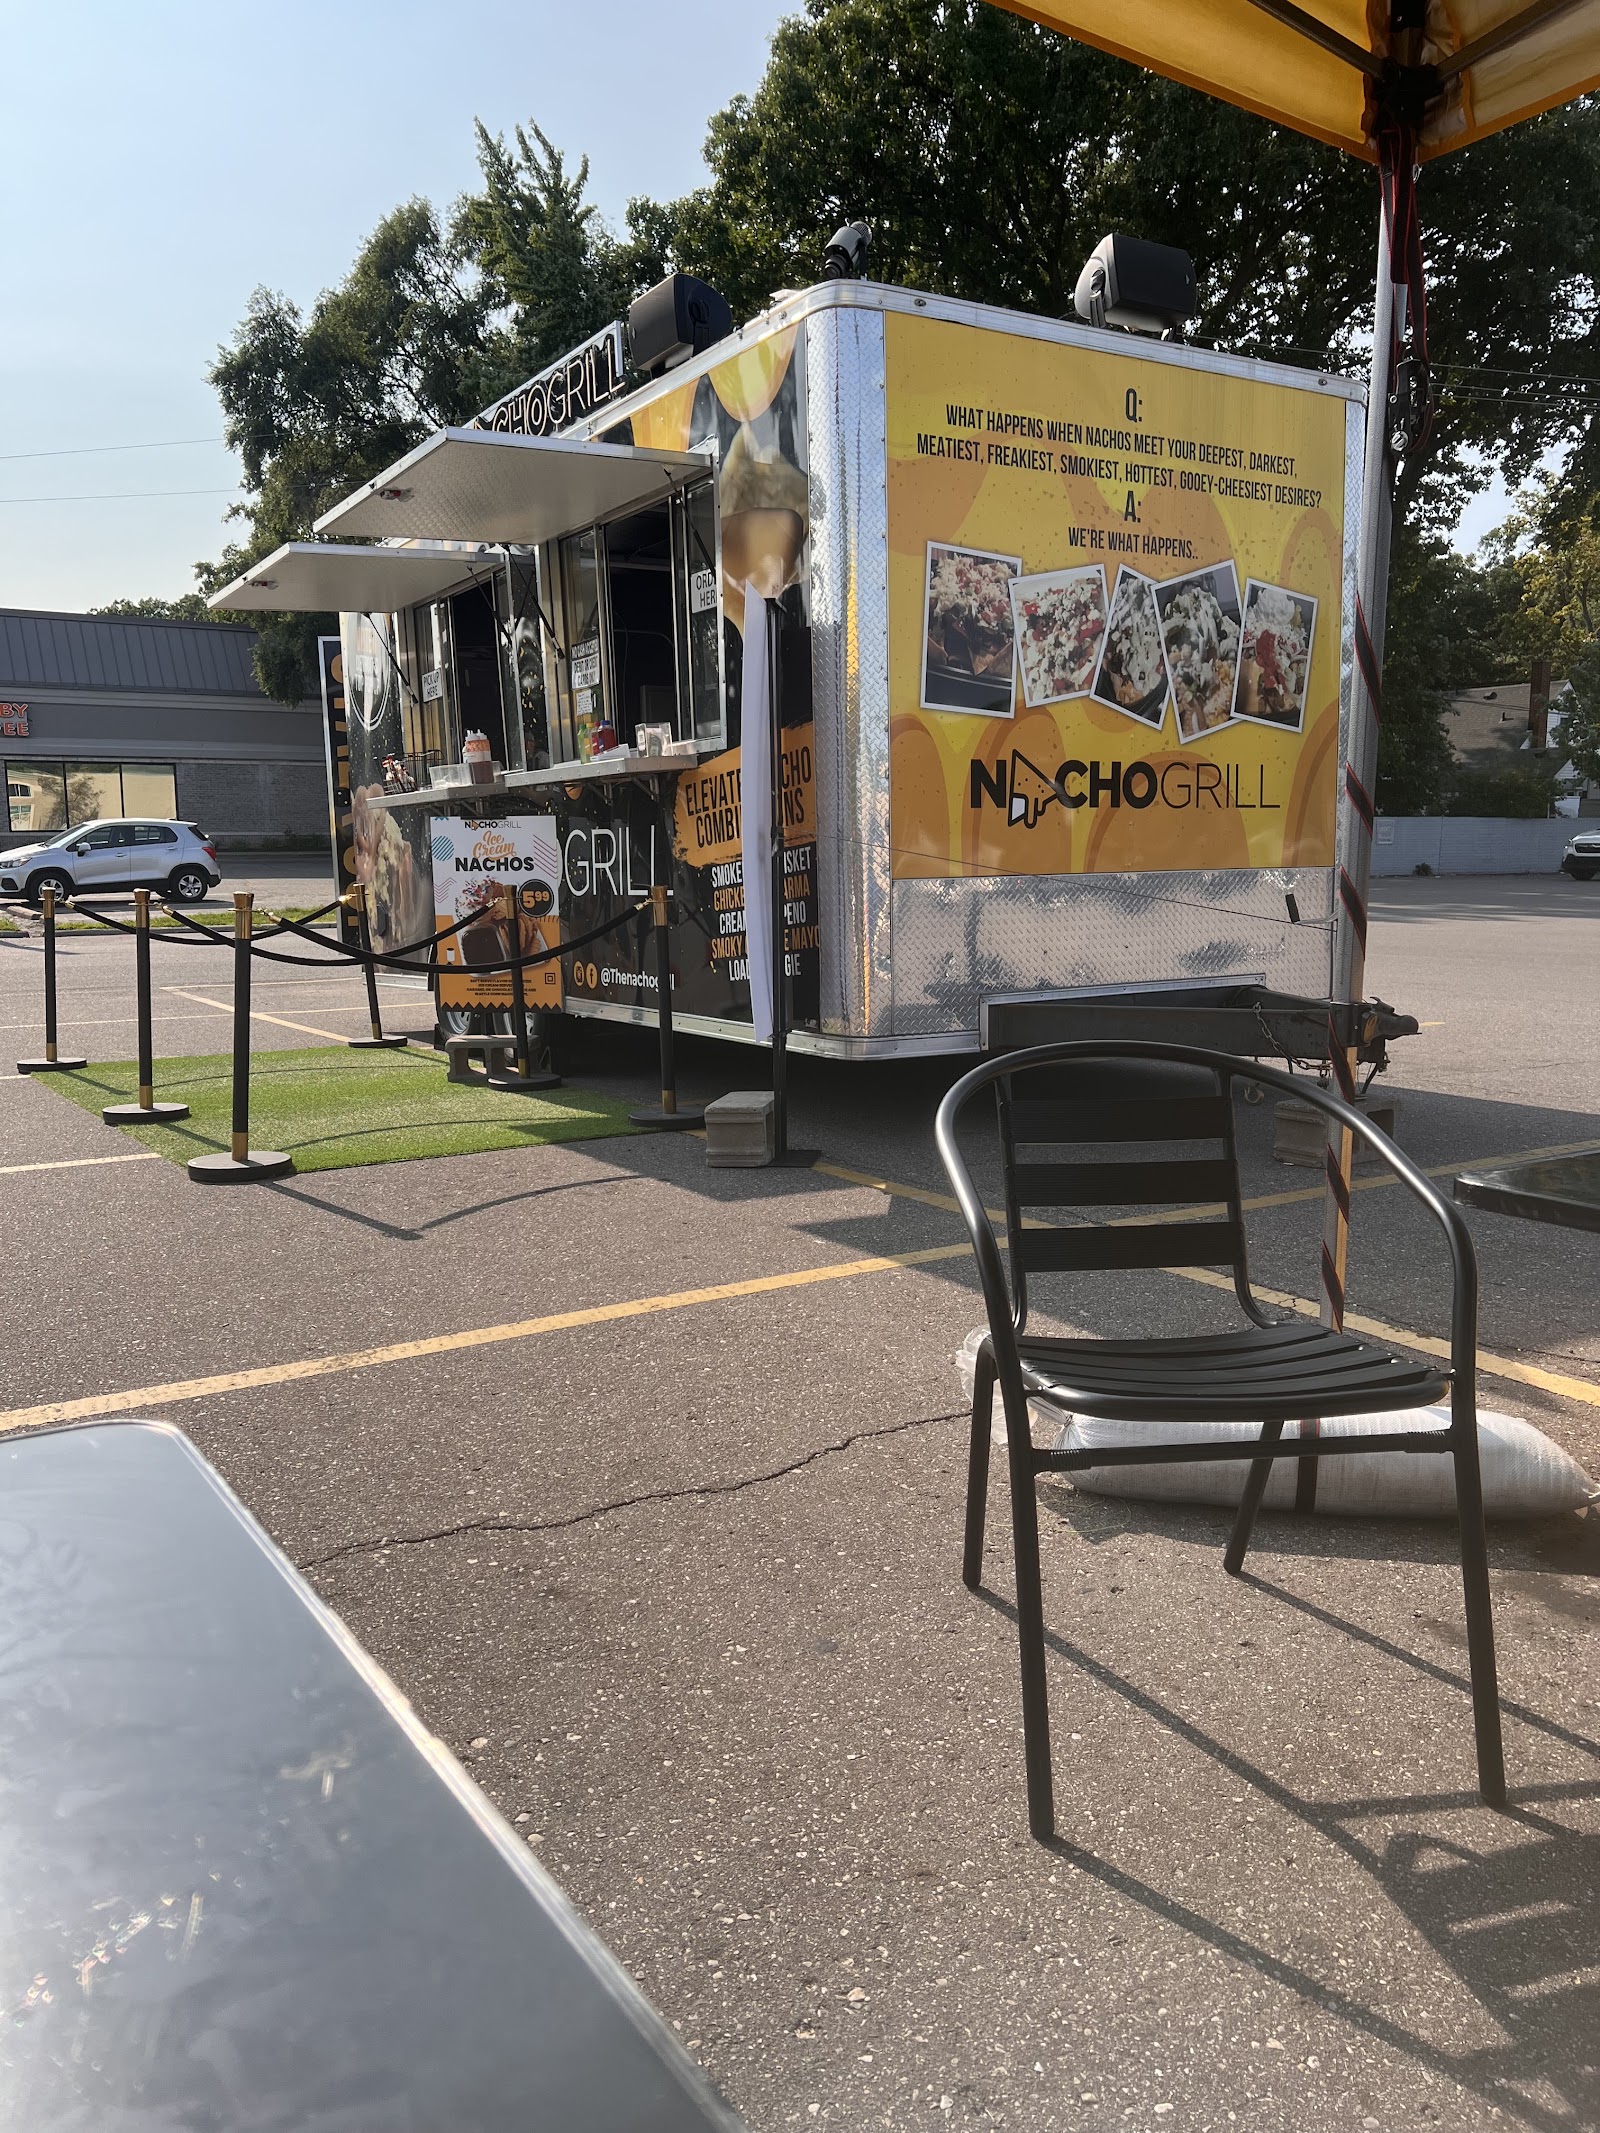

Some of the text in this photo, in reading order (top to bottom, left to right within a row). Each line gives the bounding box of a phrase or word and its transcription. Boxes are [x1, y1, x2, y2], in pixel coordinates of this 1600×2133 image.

[1126, 388, 1142, 423] Q:
[946, 404, 1298, 479] WHAT HAPPENS WHEN NACHOS MEET YOUR DEEPEST, DARKEST,
[917, 432, 1322, 508] MEATIEST, FREAKIEST, SMOKIEST, HOTTEST, GOOEY-CHEESIEST DESIRES?
[1124, 490, 1142, 523] A:
[1068, 526, 1105, 549] WE'RE
[1108, 530, 1140, 553] WHAT
[696, 572, 717, 590] ORD
[700, 589, 718, 608] HER
[0, 703, 28, 718] BY
[0, 721, 29, 736] EE
[782, 746, 812, 790] CHO
[473, 842, 517, 860] Cream
[482, 830, 504, 846] Ice
[455, 857, 535, 872] NACHOS
[557, 825, 674, 897] GRILL
[711, 846, 811, 888] SMOKE ISKET
[713, 885, 745, 912] CHICKE
[711, 935, 742, 960] SMOKY
[791, 925, 820, 950] MAYO
[784, 953, 802, 977] GIE
